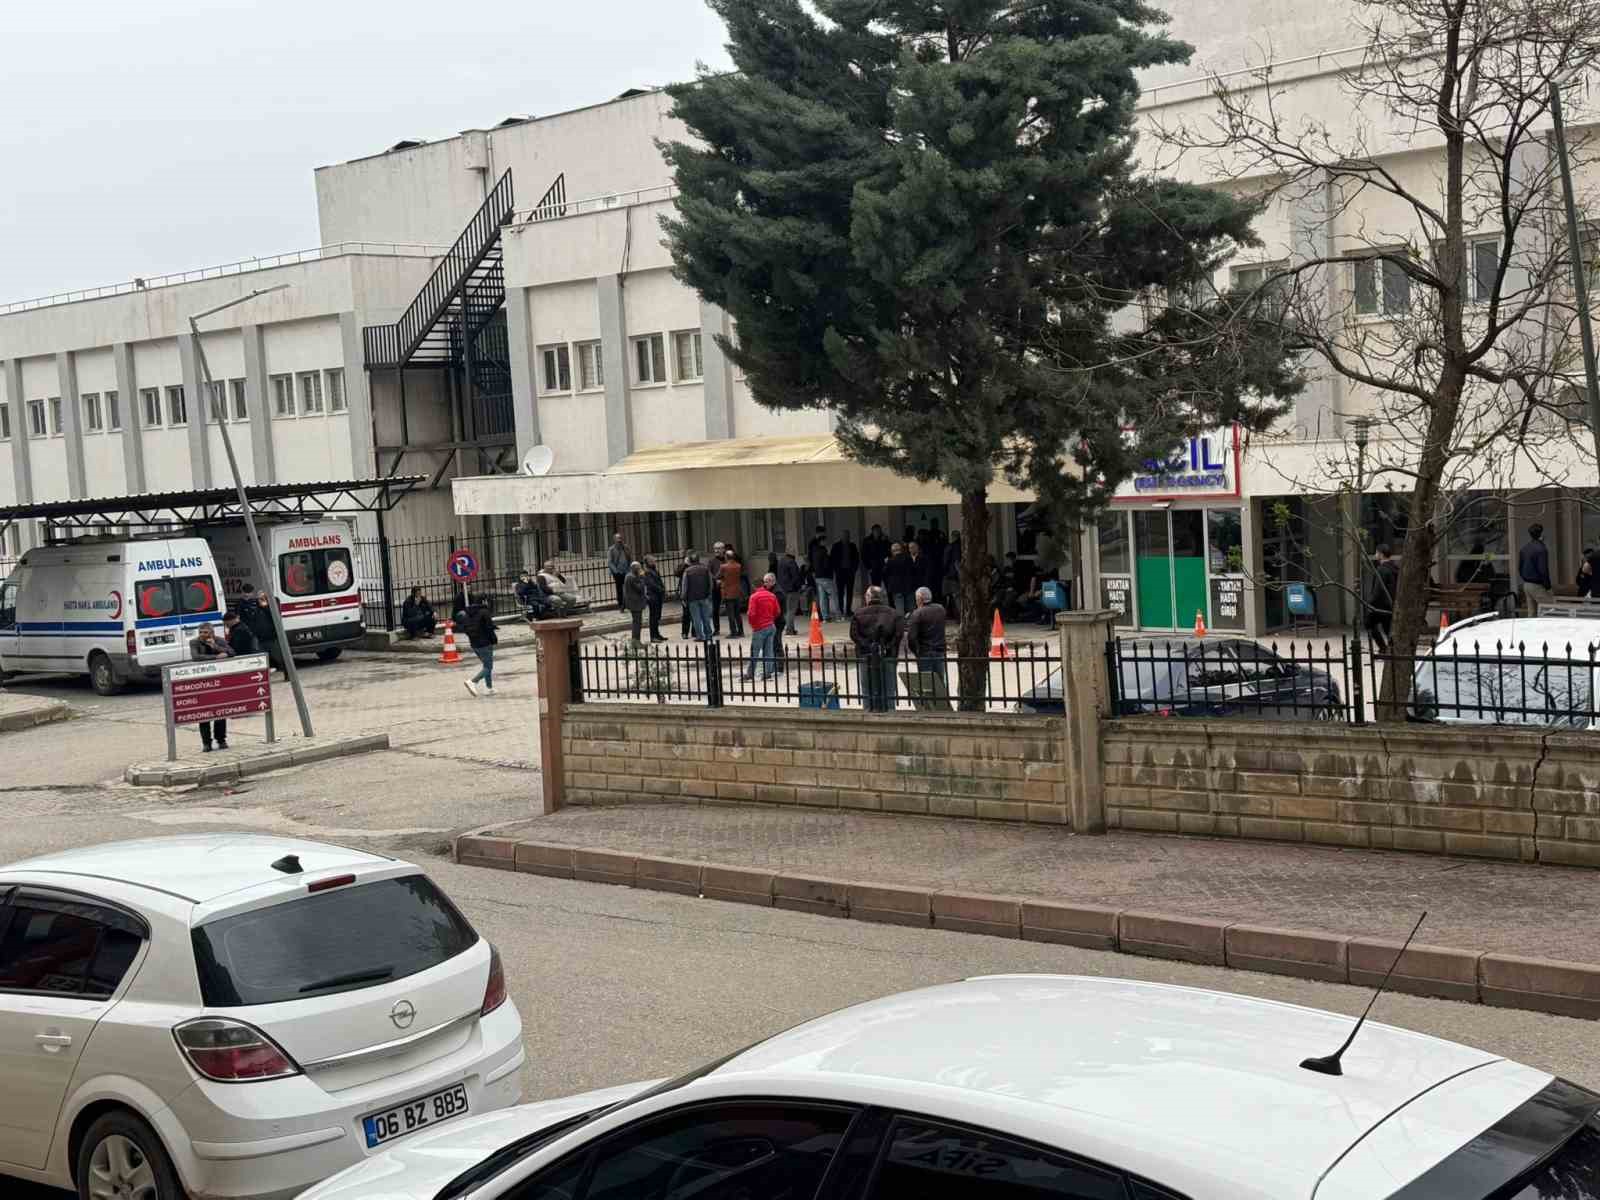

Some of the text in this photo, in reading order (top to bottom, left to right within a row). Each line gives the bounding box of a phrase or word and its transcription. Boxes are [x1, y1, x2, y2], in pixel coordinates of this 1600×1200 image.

[288, 535, 342, 549] AMBULANS
[138, 557, 203, 572] AMBULANS
[1220, 592, 1237, 603] HASTA
[178, 705, 247, 721] PERSONEL OTOPARK
[375, 1088, 466, 1139] 06 BZ 885
